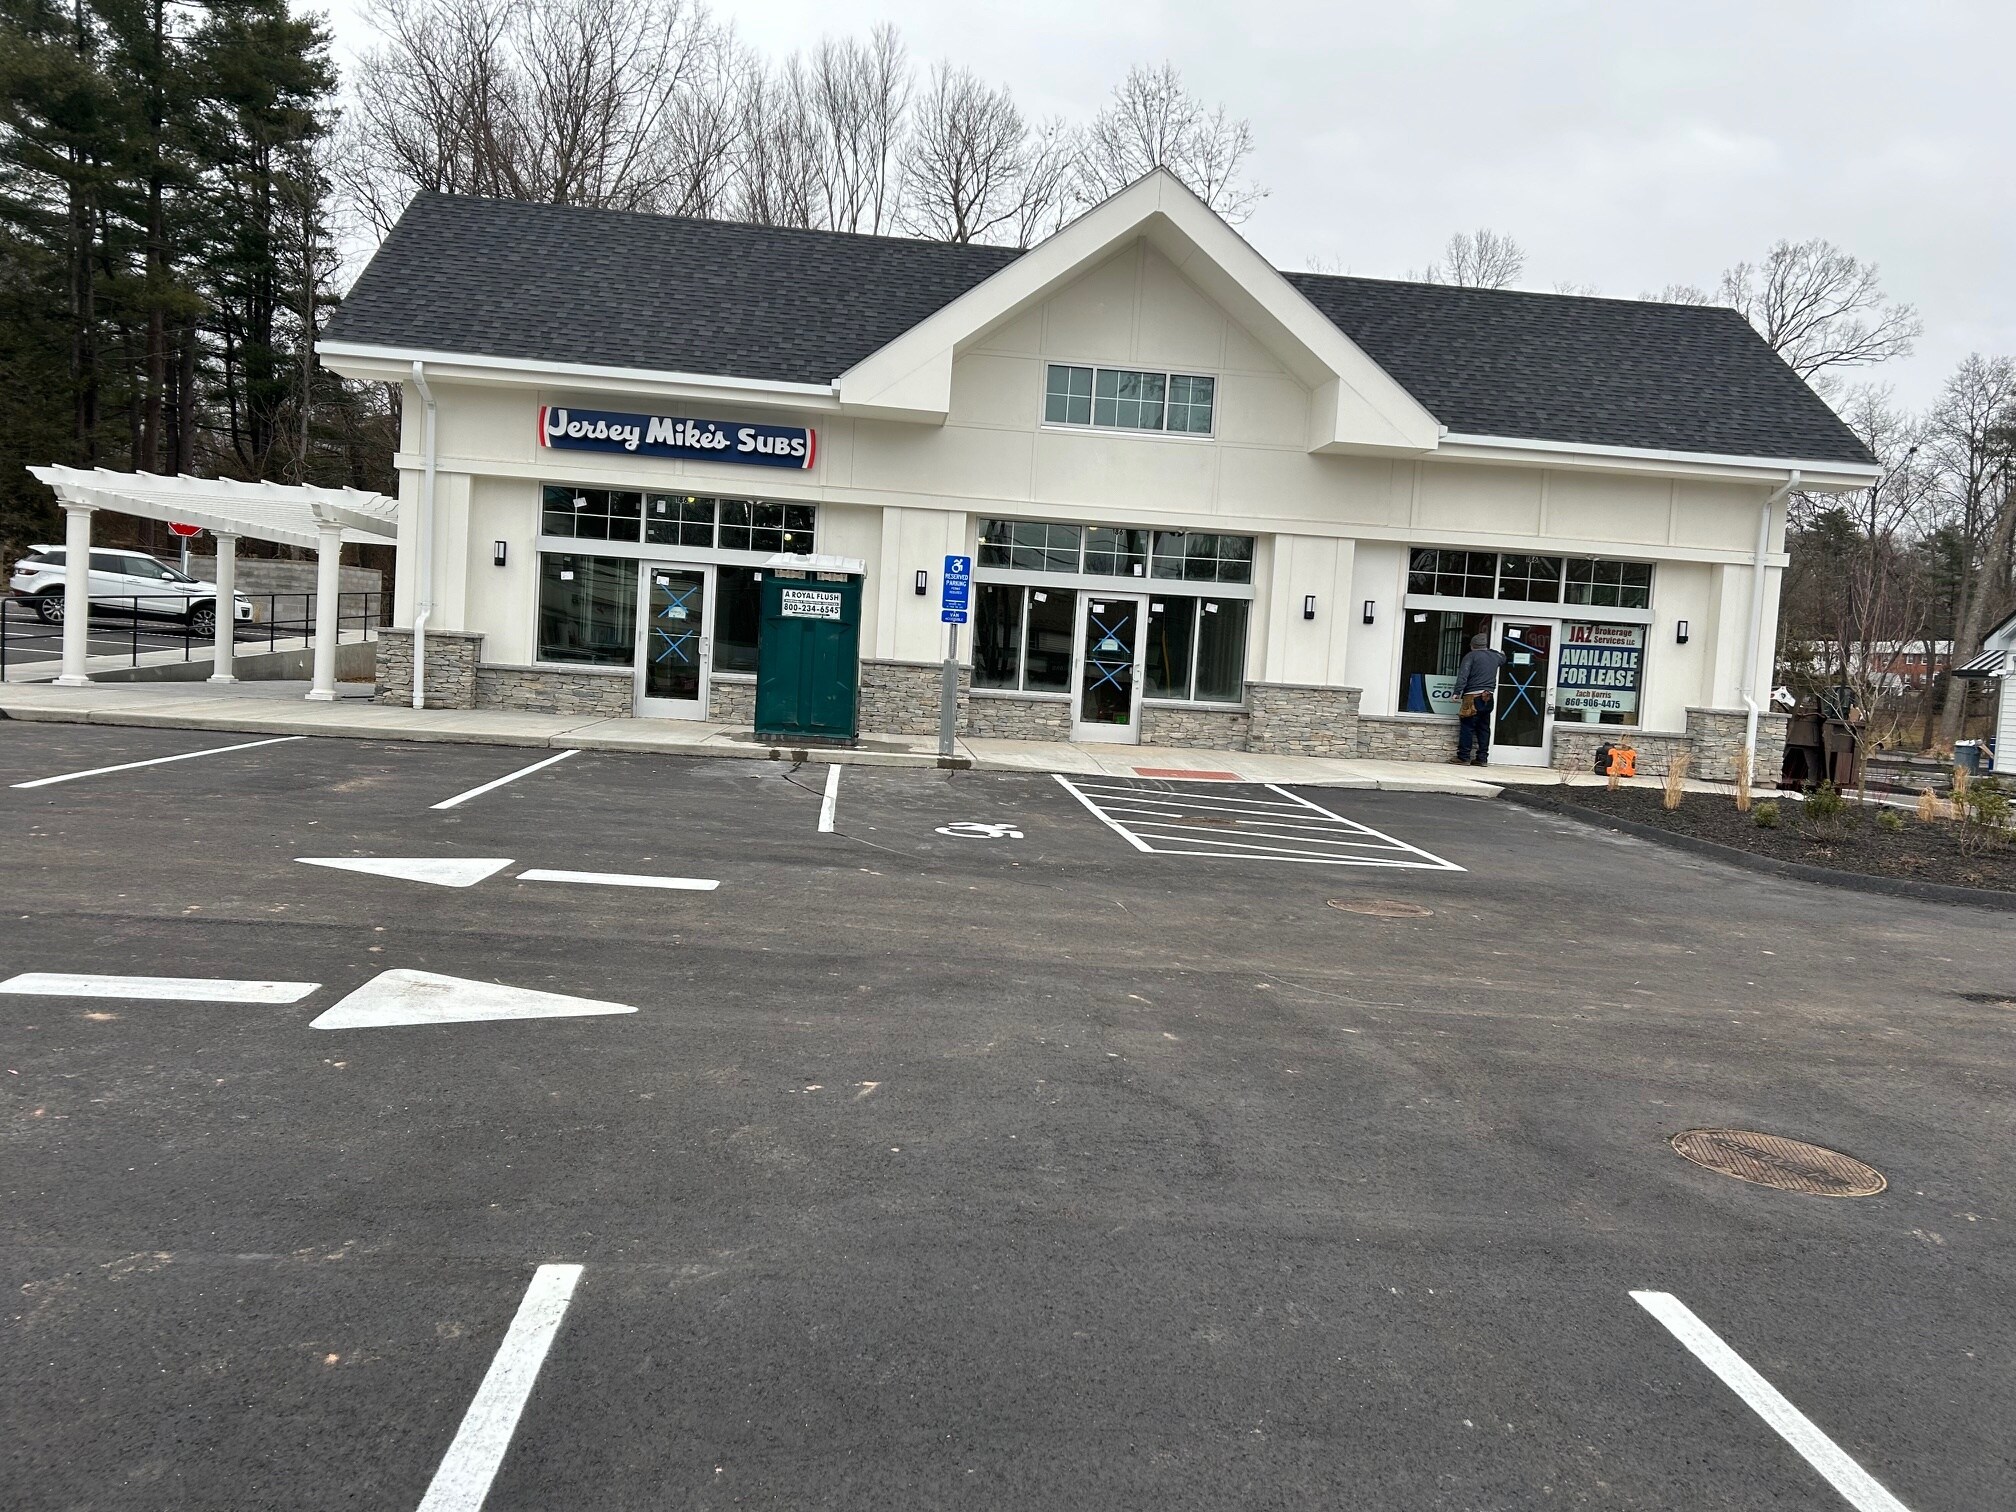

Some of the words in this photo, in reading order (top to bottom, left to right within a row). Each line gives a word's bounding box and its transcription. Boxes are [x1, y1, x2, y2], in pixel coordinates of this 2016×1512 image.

[548, 409, 640, 451] Jersey
[645, 416, 731, 450] Mike's
[945, 573, 968, 581] RESERVED
[792, 592, 815, 600] ROYAL
[816, 593, 839, 601] FLUSH
[784, 602, 839, 614] 800-234-6545
[1569, 625, 1593, 643] JAZ
[1595, 627, 1633, 637] Brokerage
[1593, 636, 1626, 645] Services
[1560, 649, 1638, 668] AVAILABLE
[1559, 668, 1587, 685] FOR
[1590, 669, 1635, 687] LEASE
[1576, 690, 1590, 698] Zach
[1565, 698, 1621, 709] 860-906-4475
